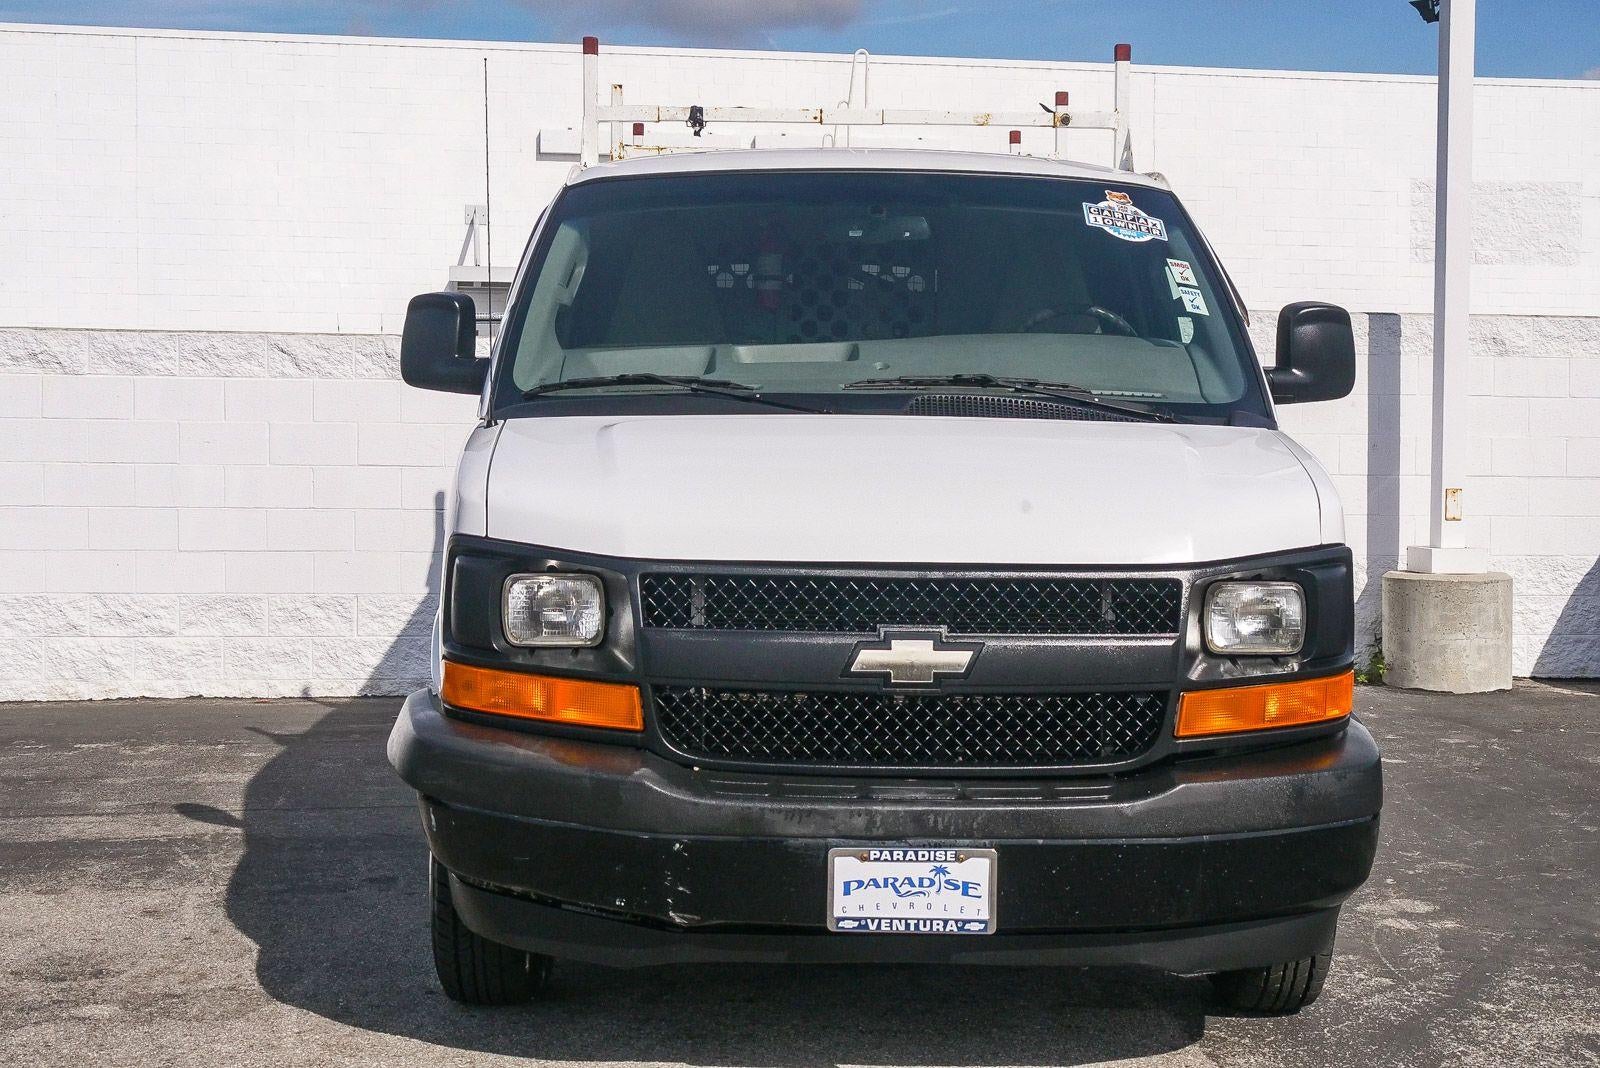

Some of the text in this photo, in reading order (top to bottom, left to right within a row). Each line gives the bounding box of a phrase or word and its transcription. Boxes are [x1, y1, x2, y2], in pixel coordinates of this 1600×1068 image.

[1088, 207, 1159, 229] CARFAX
[1103, 218, 1163, 237] OWNER
[1169, 261, 1190, 270] SMOG
[1180, 275, 1191, 283] OK
[1180, 289, 1201, 298] SAFETY
[1191, 303, 1202, 311] OK
[869, 850, 957, 861] PARADISE
[842, 866, 983, 899] PARADISE
[841, 902, 981, 917] CHEVROLET
[867, 919, 958, 932] VENTURA
